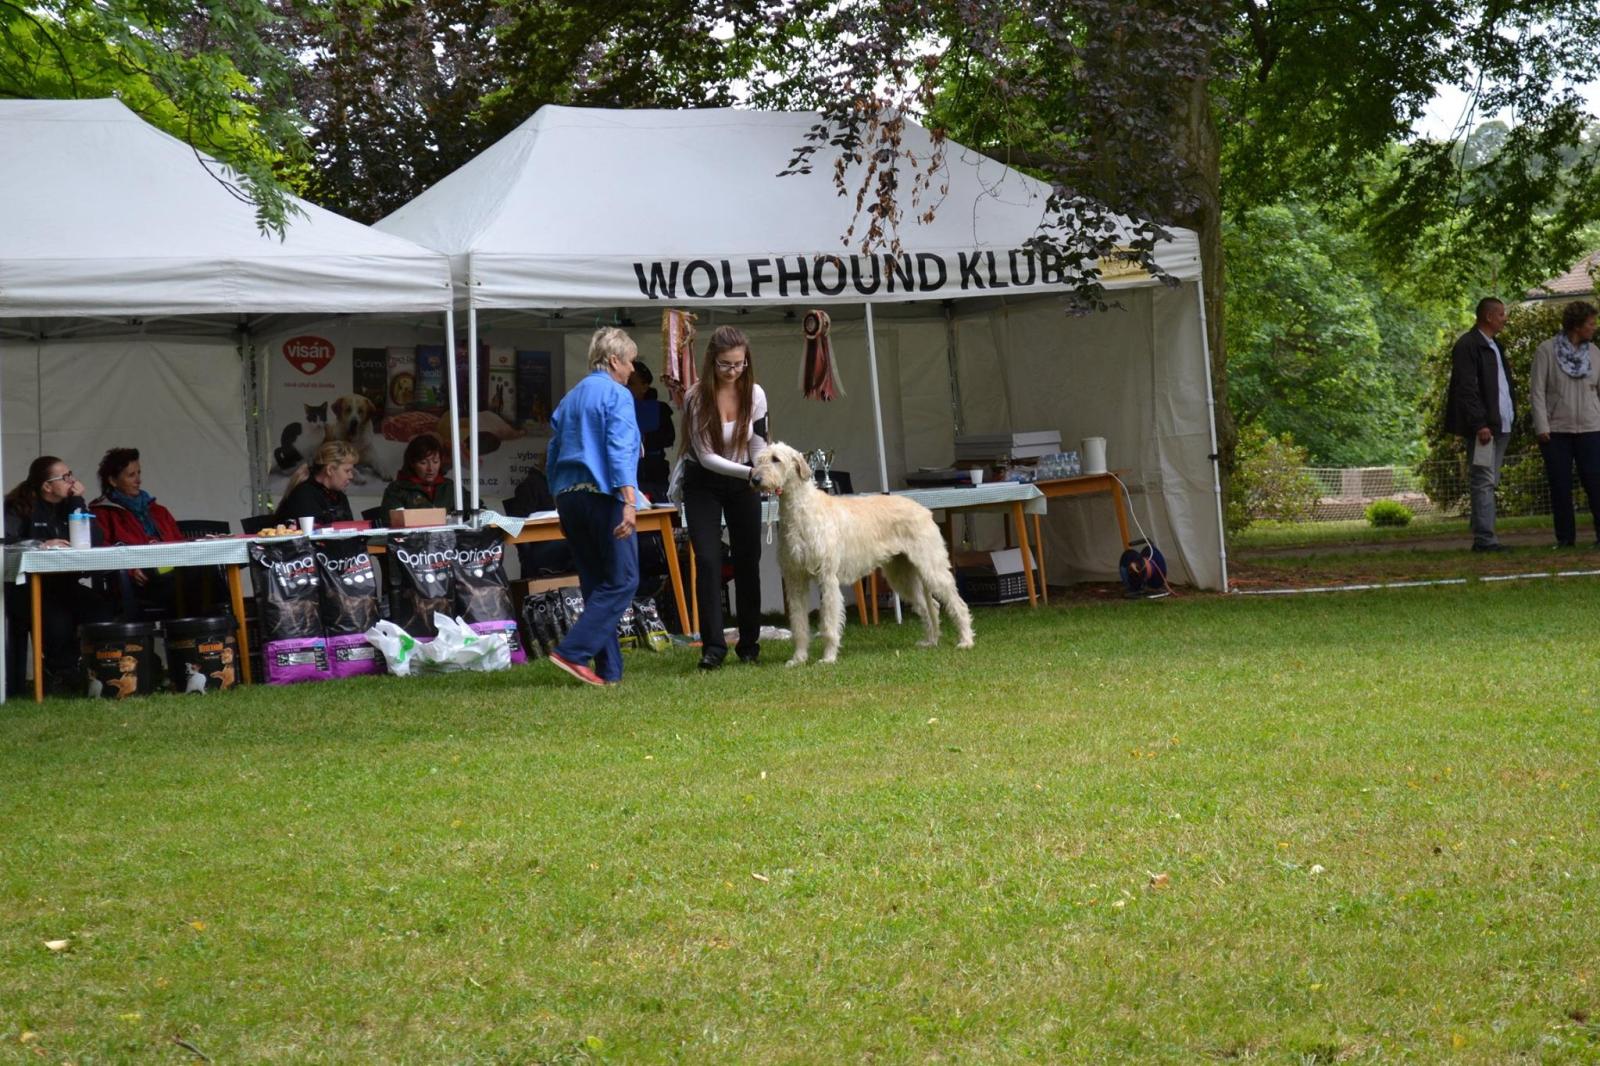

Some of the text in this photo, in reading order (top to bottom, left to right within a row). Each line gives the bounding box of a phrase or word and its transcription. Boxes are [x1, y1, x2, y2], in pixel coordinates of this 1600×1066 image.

[632, 249, 1065, 299] WOLFHOUND KLUB
[287, 341, 330, 359] visán
